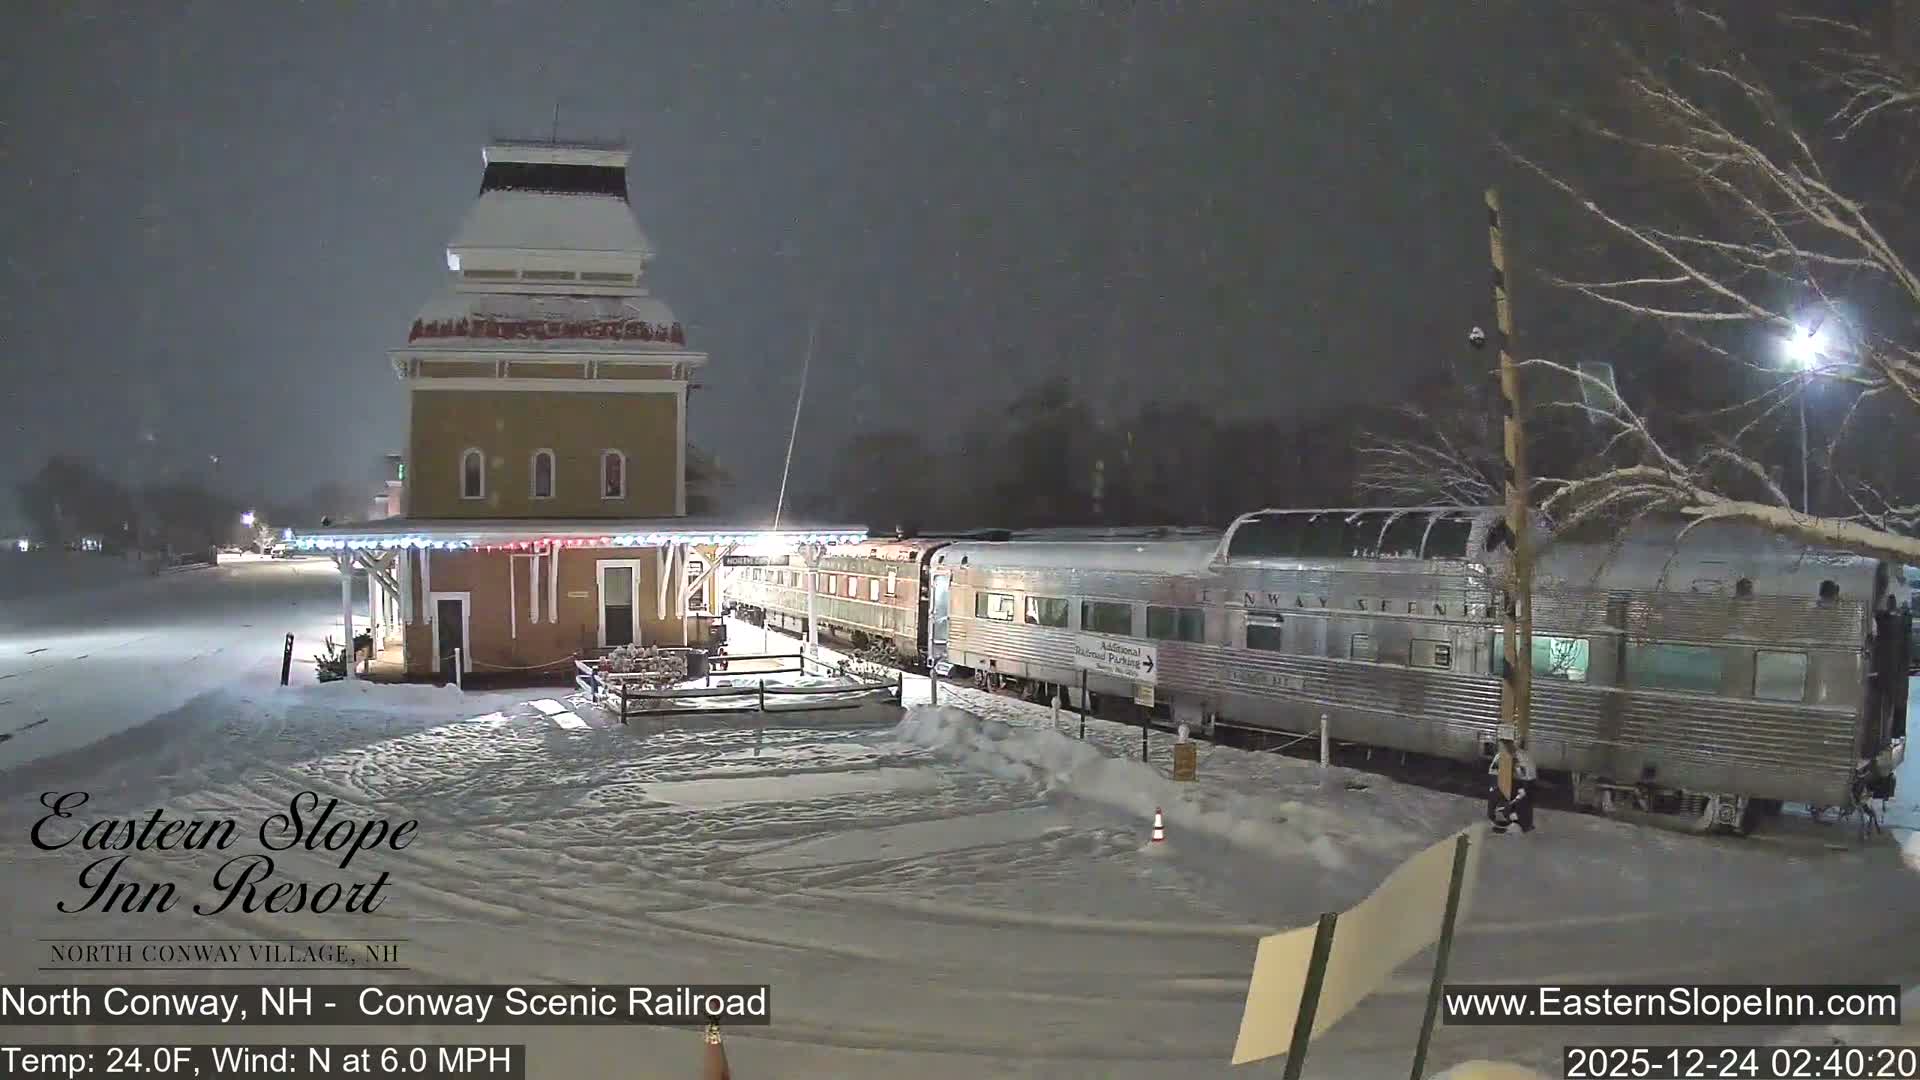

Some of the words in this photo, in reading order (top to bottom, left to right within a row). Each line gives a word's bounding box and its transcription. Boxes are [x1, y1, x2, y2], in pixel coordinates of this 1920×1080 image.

[1074, 645, 1106, 660] Railroad
[1108, 653, 1141, 670] Parking
[1101, 641, 1141, 656] Additional
